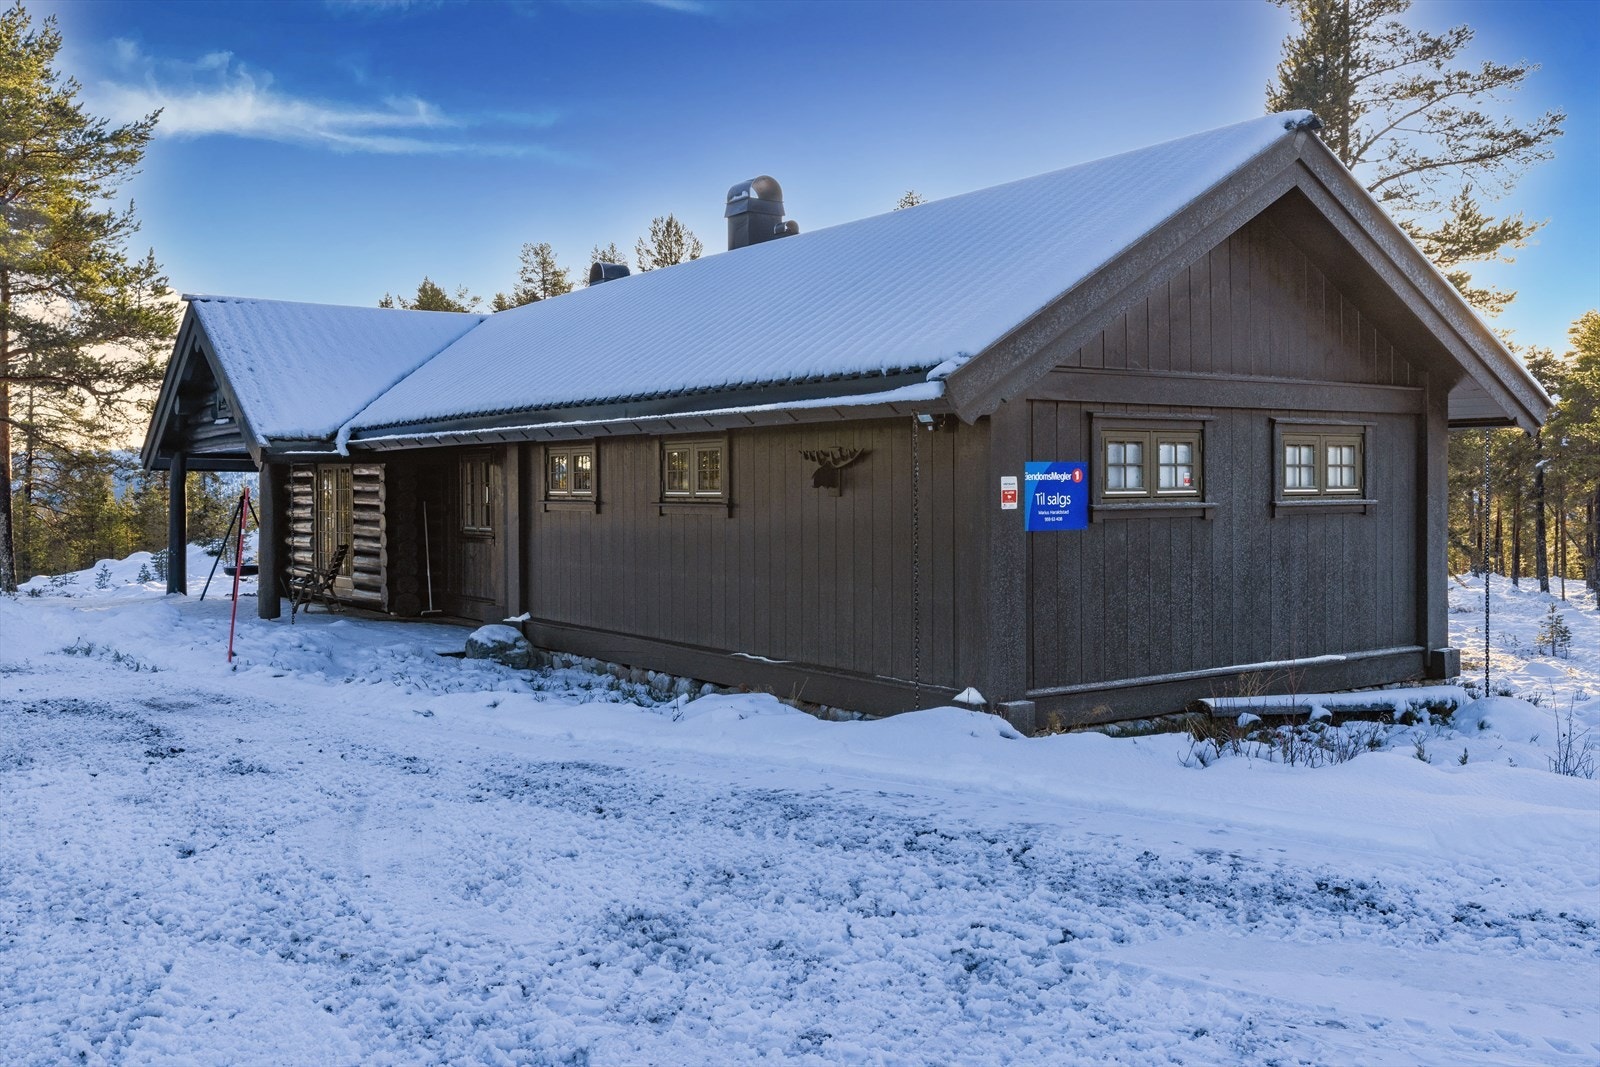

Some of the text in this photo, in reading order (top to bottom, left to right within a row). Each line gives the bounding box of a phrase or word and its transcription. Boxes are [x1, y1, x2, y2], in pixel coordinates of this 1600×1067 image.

[1074, 470, 1080, 480] 1
[1035, 492, 1072, 508] Til salgs
